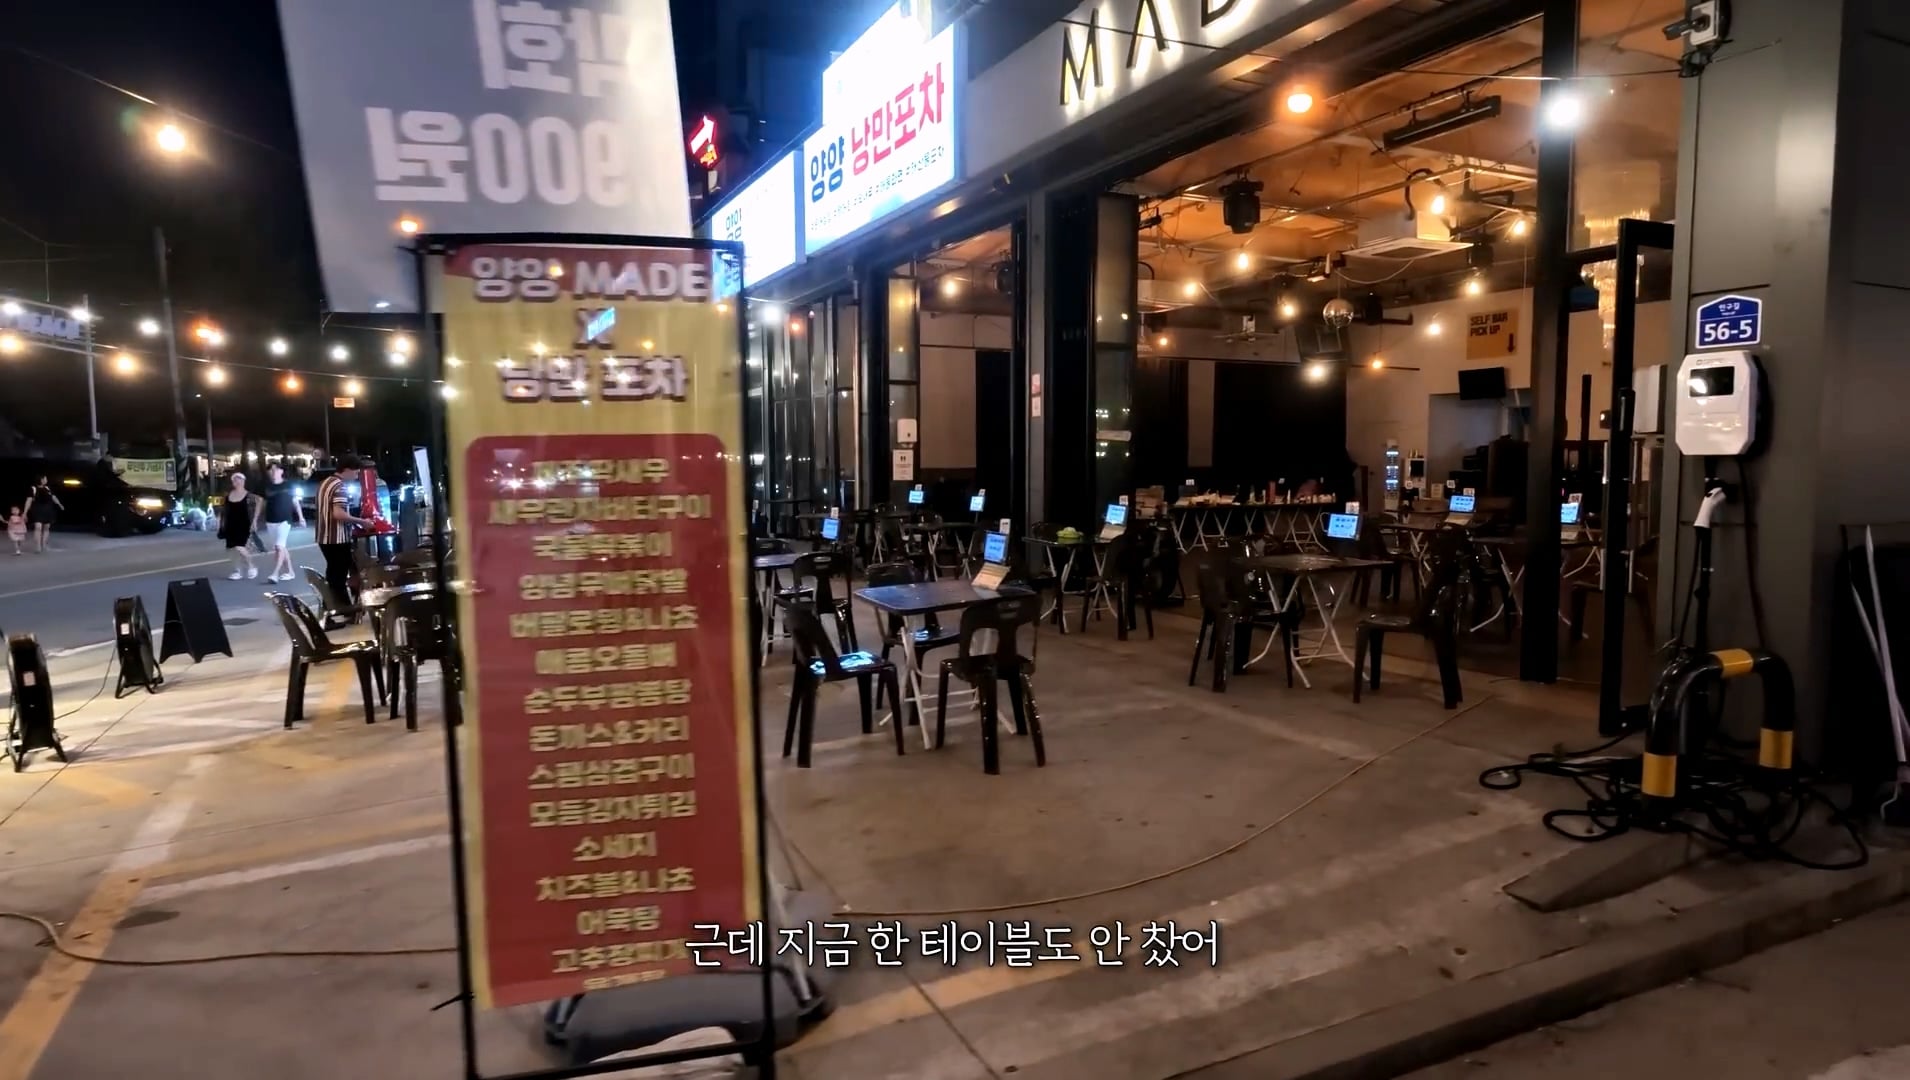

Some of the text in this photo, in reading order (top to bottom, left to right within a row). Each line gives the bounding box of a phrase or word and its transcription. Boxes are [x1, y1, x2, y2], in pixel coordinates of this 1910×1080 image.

[811, 62, 945, 203] 양양 낭만포차
[472, 256, 560, 299] 양양
[574, 260, 711, 298] MADE
[1470, 312, 1508, 326] SELF BAR
[1470, 325, 1501, 337] PICK UP
[1703, 319, 1753, 342] 56-5
[601, 355, 689, 400] 포차
[576, 905, 662, 934] 어묵탕
